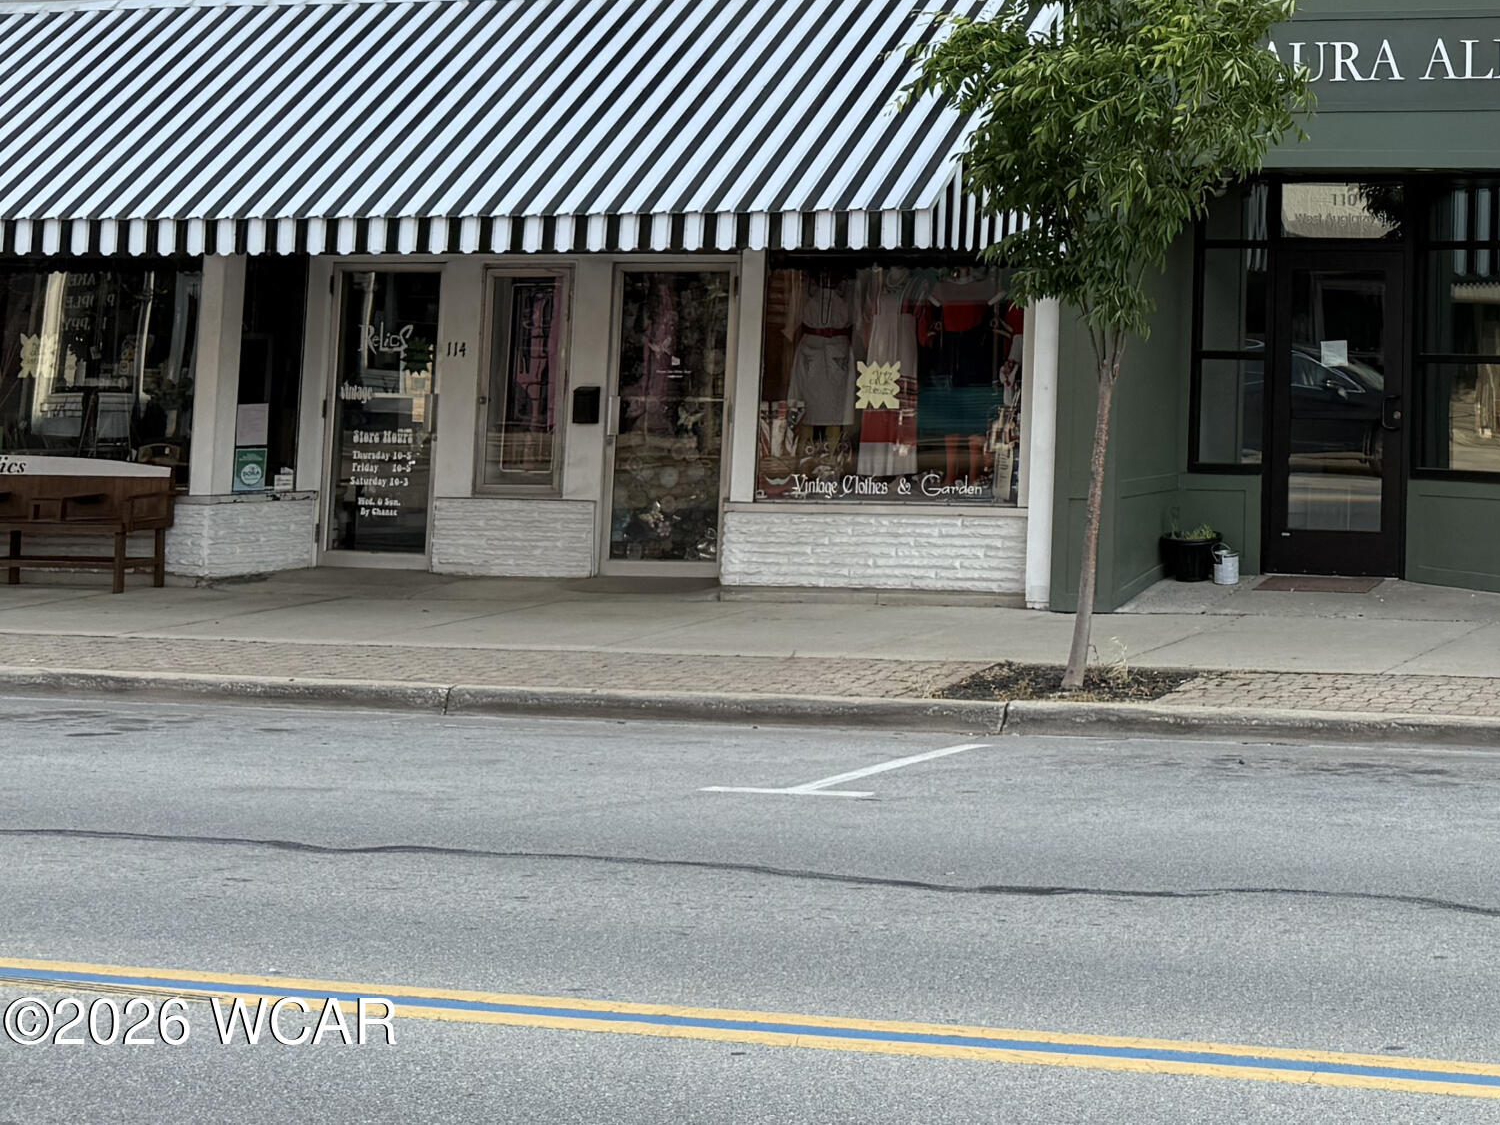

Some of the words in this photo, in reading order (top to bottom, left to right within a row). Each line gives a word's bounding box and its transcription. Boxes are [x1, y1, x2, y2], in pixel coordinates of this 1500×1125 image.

[1331, 193, 1358, 206] 110
[446, 341, 466, 358] 114
[352, 430, 380, 443] Store
[352, 451, 390, 461] Thursday
[0, 456, 26, 473] ics
[352, 462, 379, 474] Friday
[349, 476, 387, 487] Saturday
[791, 474, 838, 498] Vintage
[839, 474, 889, 497] Clothes
[897, 477, 912, 495] &
[921, 474, 983, 497] Garden
